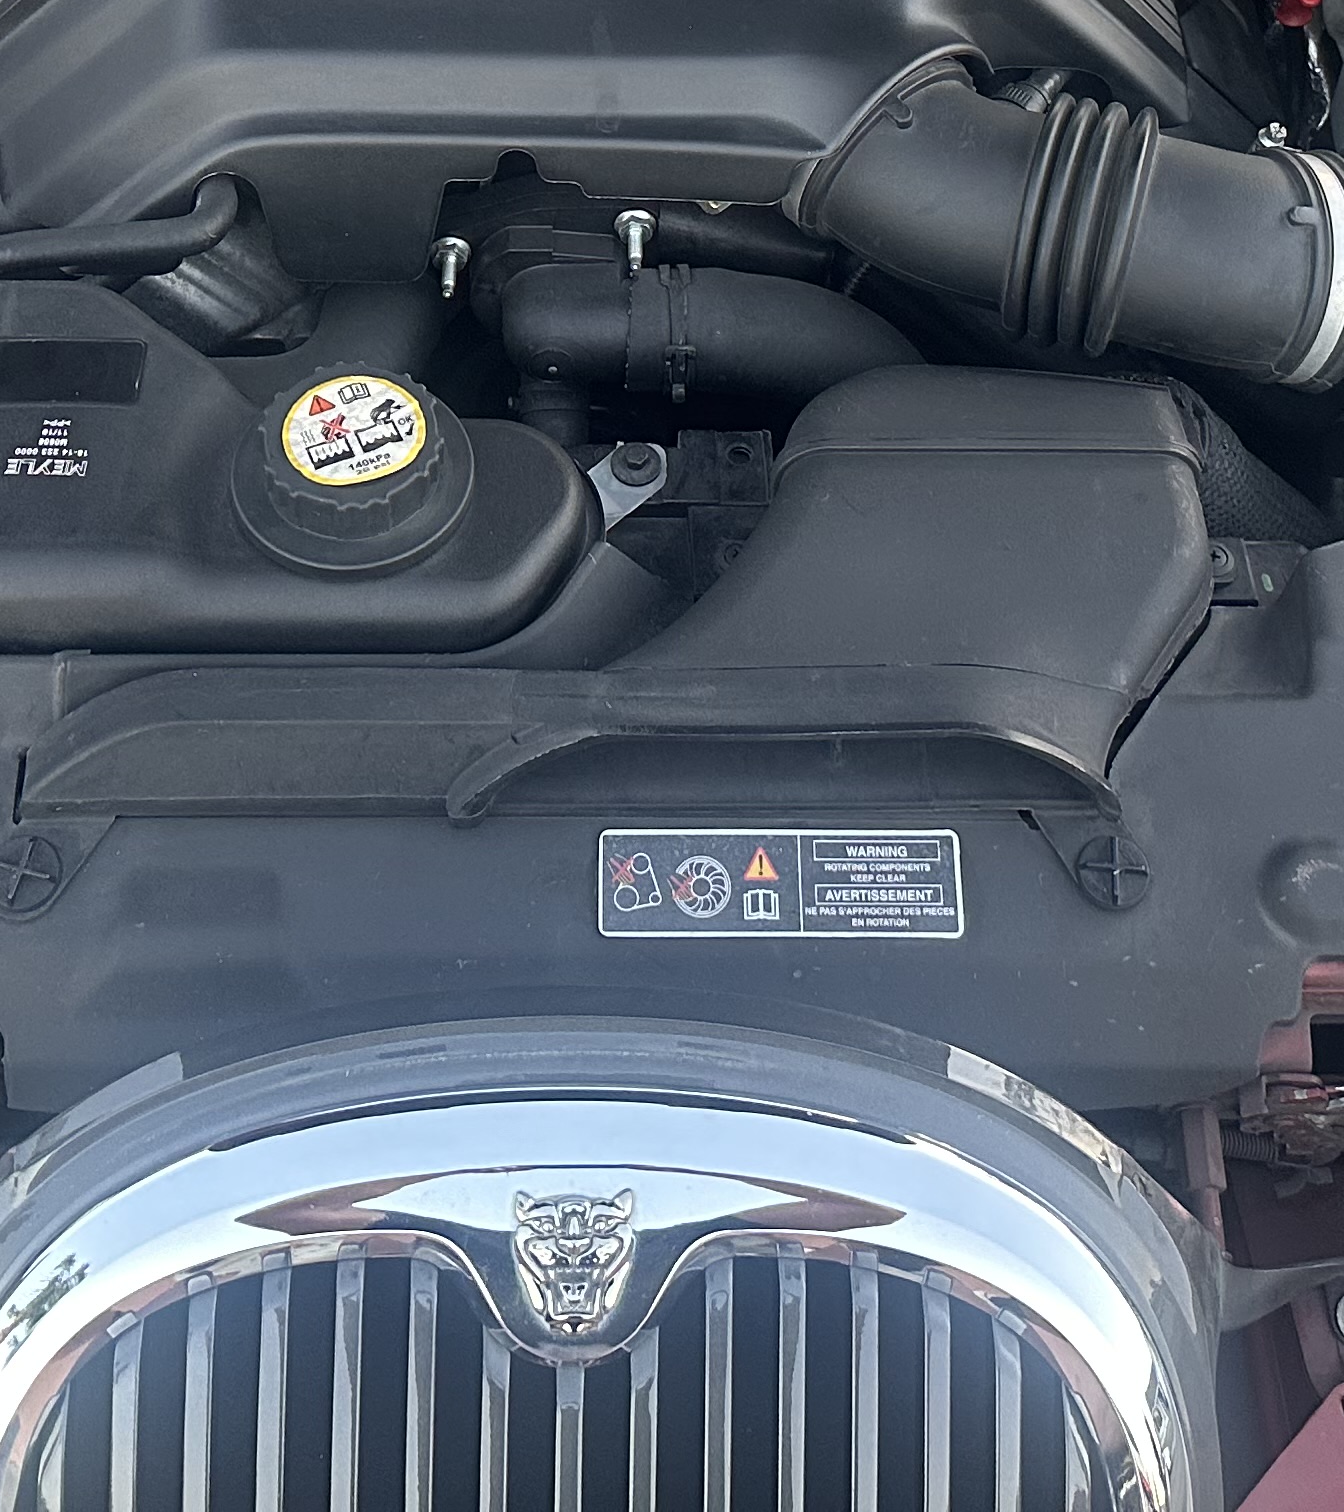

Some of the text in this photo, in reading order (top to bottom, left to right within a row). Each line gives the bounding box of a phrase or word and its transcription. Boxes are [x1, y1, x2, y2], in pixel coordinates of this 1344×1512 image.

[397, 414, 414, 426] OK
[3, 458, 89, 477] MEYLE
[348, 452, 392, 471] 140kPa
[845, 845, 908, 858] WARNING
[824, 863, 931, 872] ROTATING COMPONENTS
[850, 874, 906, 883] KEEP CLEAR
[824, 889, 934, 902] AVERTISSEMENT
[804, 906, 818, 916] NE
[819, 907, 837, 916] PAS
[903, 907, 922, 916] DES
[851, 918, 910, 928] EN ROTATION
